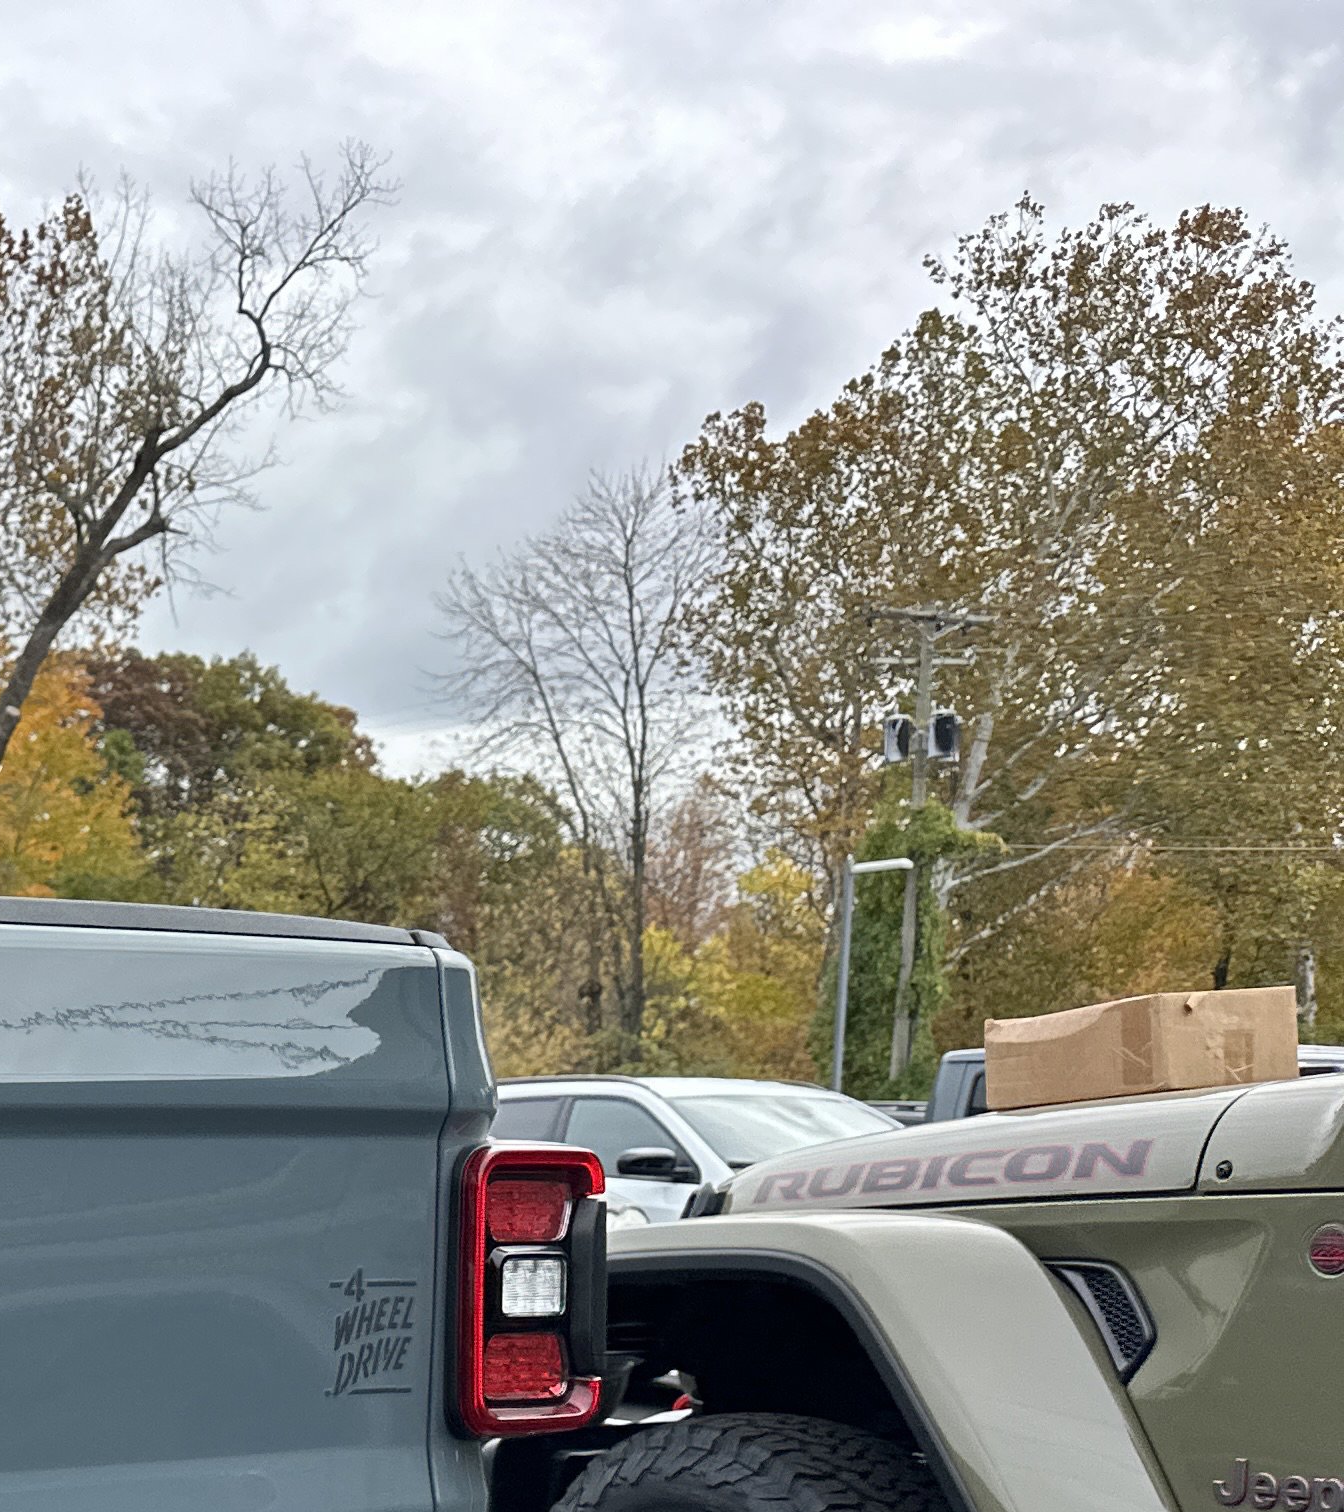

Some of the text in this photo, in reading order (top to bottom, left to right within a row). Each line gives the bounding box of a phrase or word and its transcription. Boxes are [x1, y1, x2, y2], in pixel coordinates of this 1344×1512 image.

[752, 1137, 1155, 1205] RUBICON
[343, 1265, 366, 1303] 4
[333, 1296, 414, 1352] WHEEL
[333, 1336, 413, 1397] DRIVE
